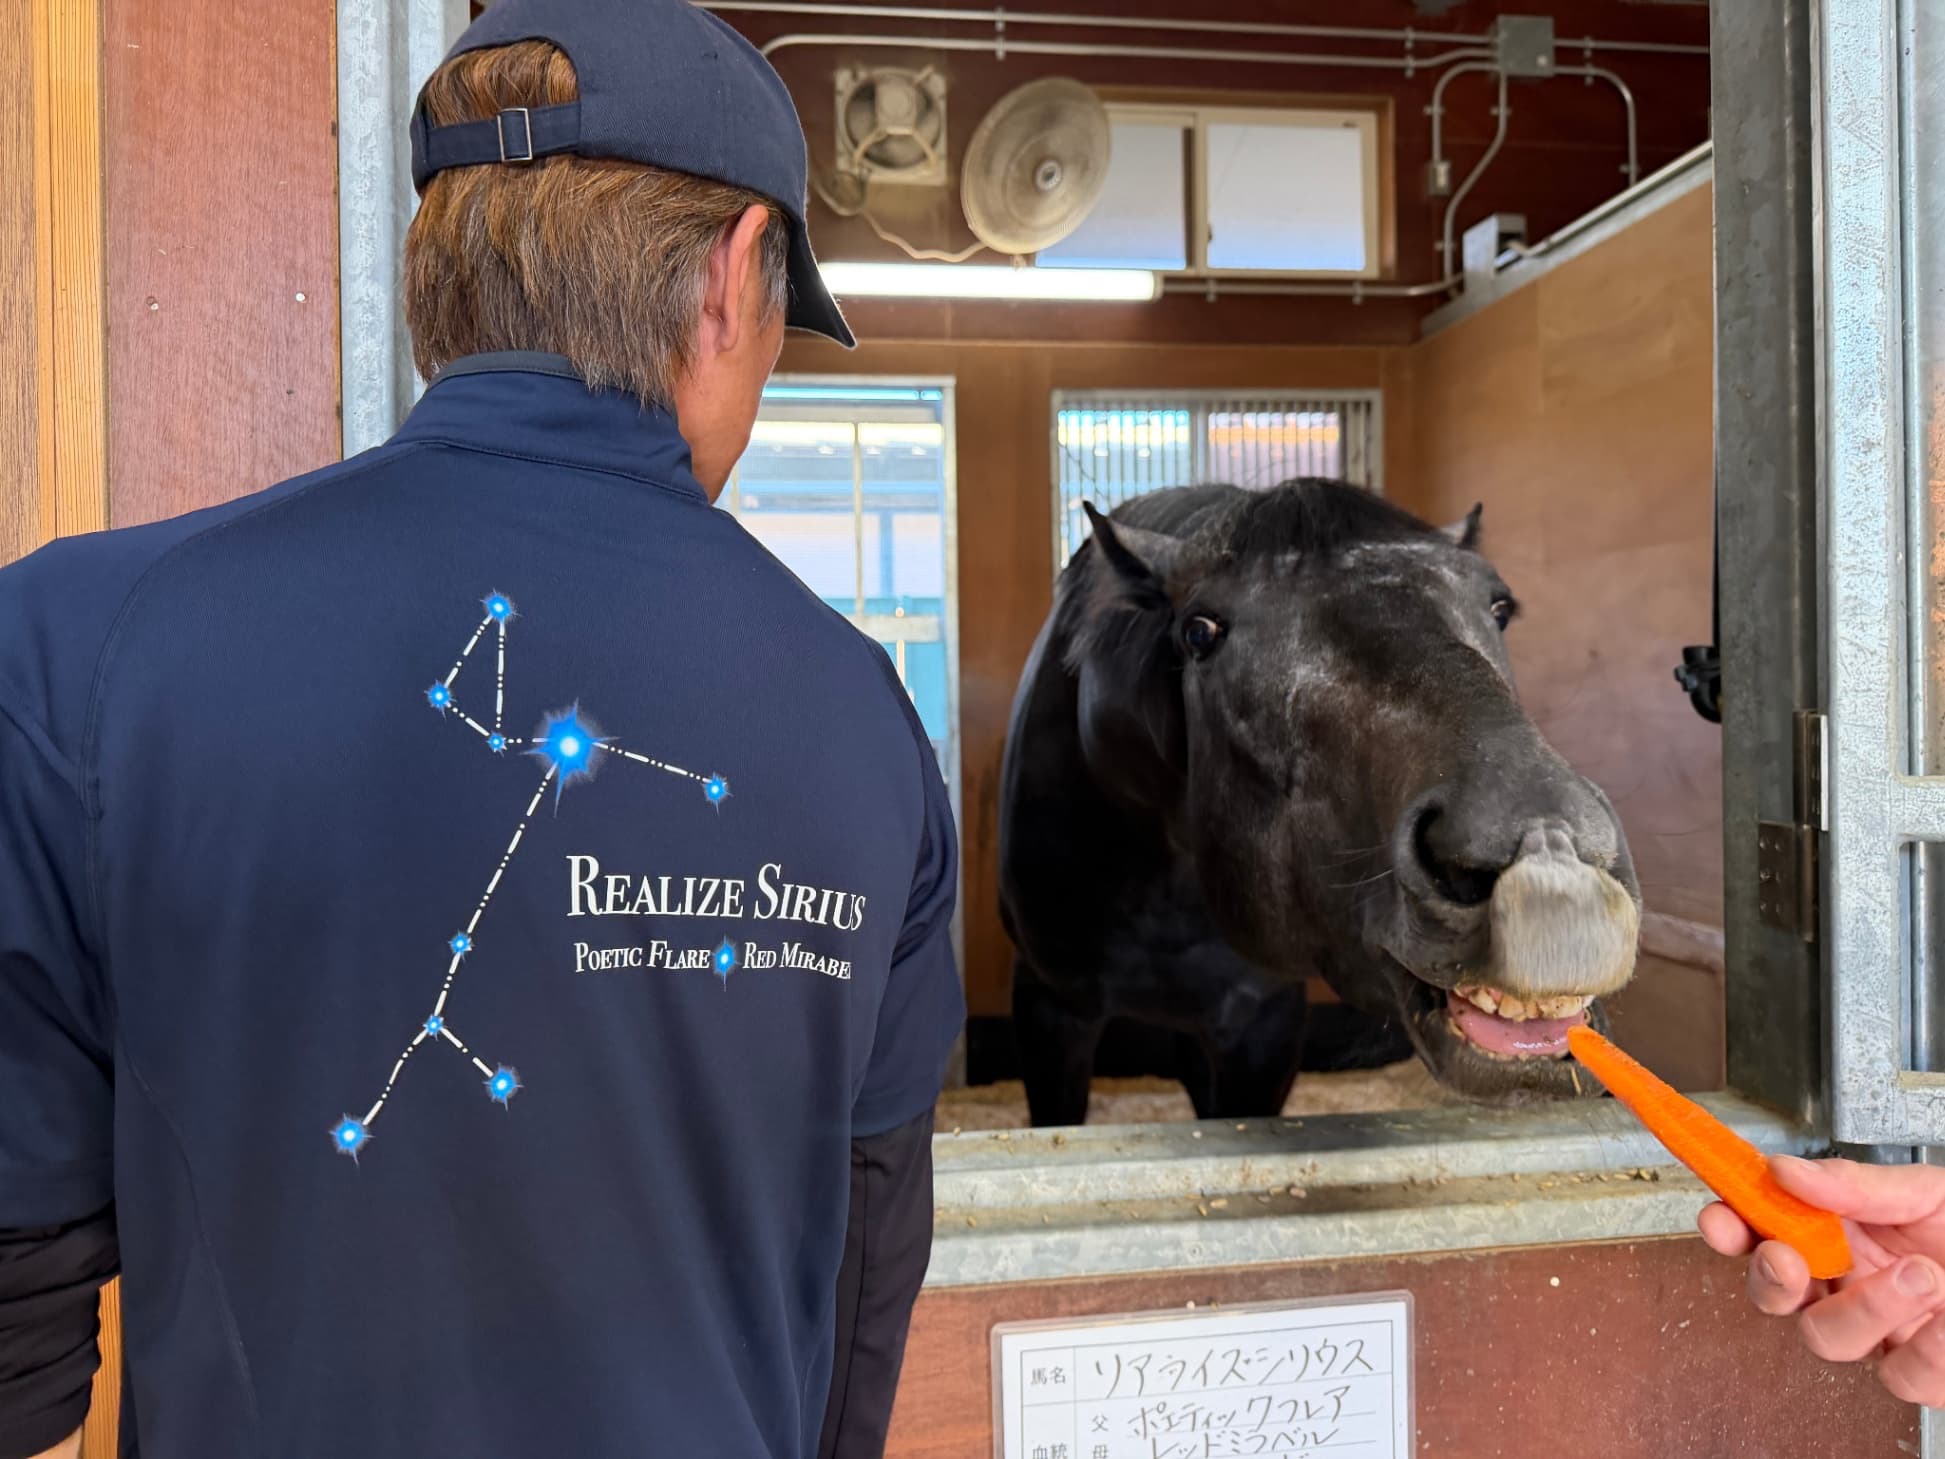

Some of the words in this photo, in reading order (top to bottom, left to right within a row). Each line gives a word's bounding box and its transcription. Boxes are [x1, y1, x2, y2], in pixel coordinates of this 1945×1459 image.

[566, 855, 744, 918] REALIZE
[753, 863, 867, 931] SIRIUS
[573, 942, 642, 972] POETIC
[646, 940, 710, 970] FLARE
[743, 942, 776, 969] RED
[779, 942, 851, 979] MIRABE
[1030, 1366, 1066, 1386] 馬名
[1095, 1338, 1374, 1399] リアライズシリウス
[1091, 1413, 1109, 1432] 父
